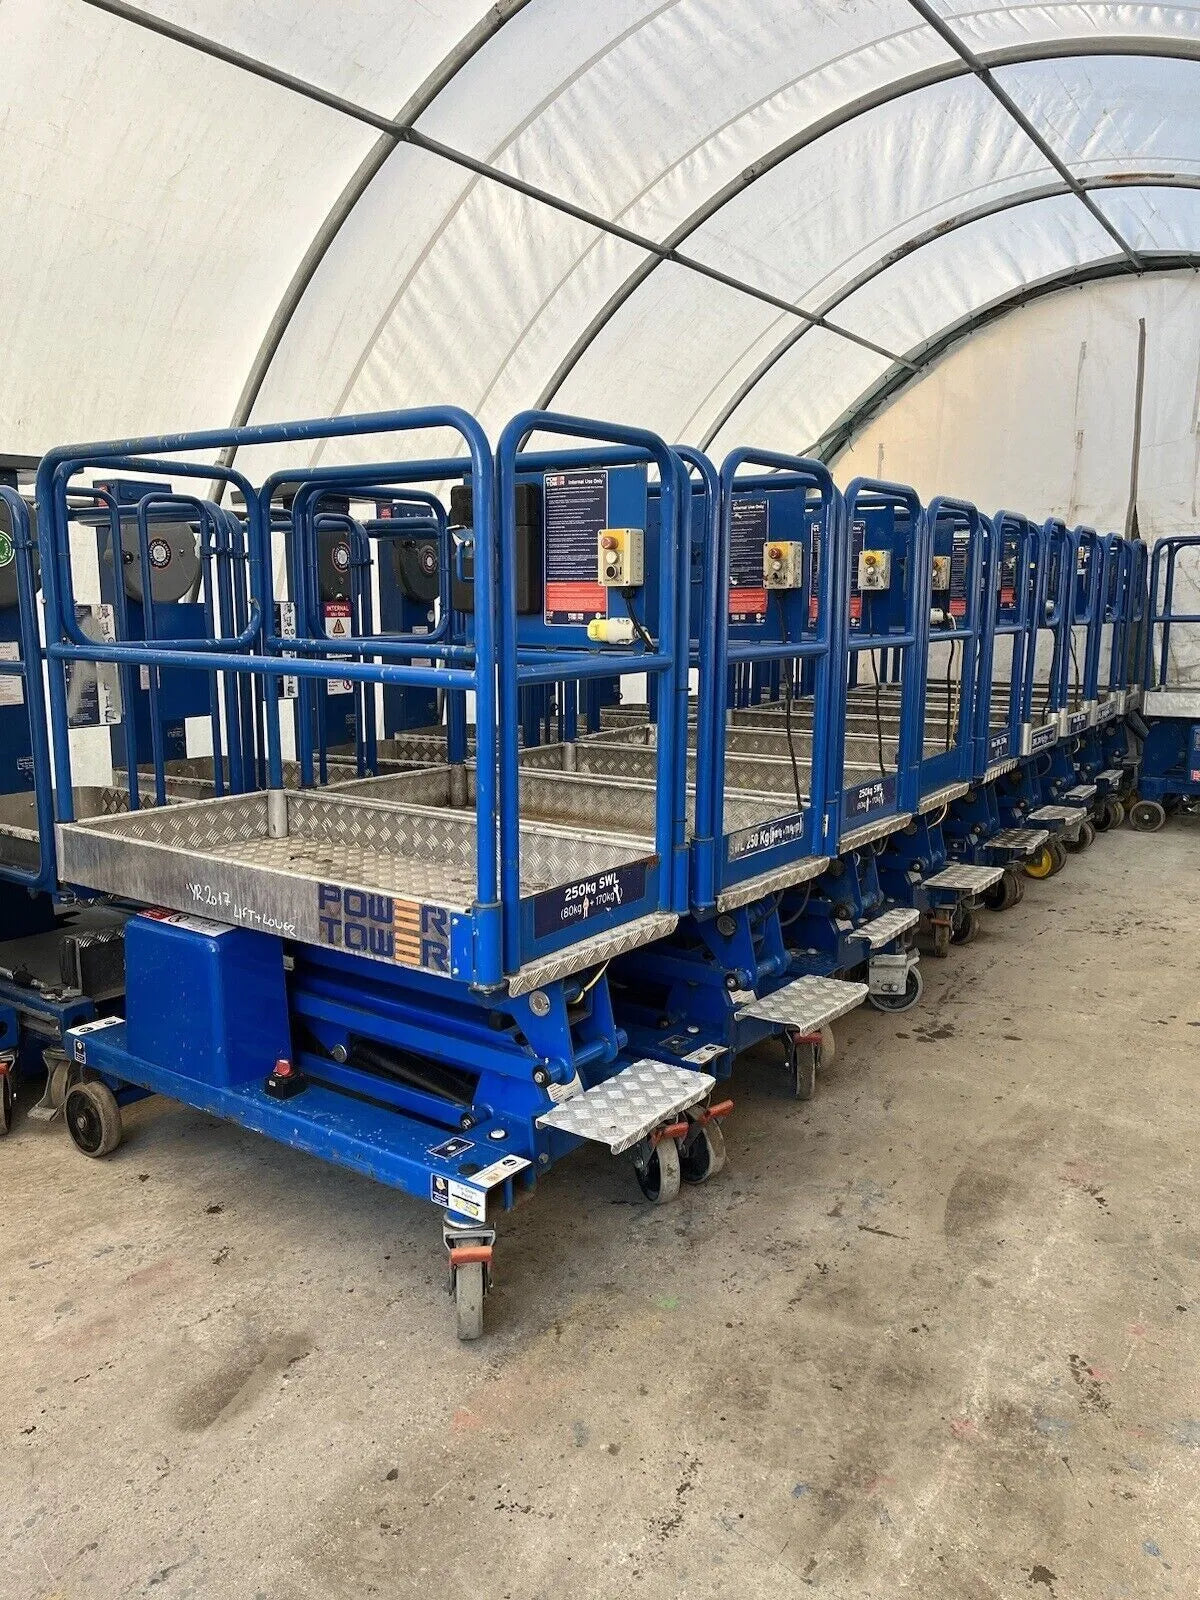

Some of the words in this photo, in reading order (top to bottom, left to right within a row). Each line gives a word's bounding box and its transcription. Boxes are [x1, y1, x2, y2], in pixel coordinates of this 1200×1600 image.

[565, 882, 597, 902] 250kg
[599, 872, 620, 889] SWL
[318, 883, 448, 938] POWER
[560, 903, 582, 920] (80kg
[318, 915, 450, 972] TOWER
